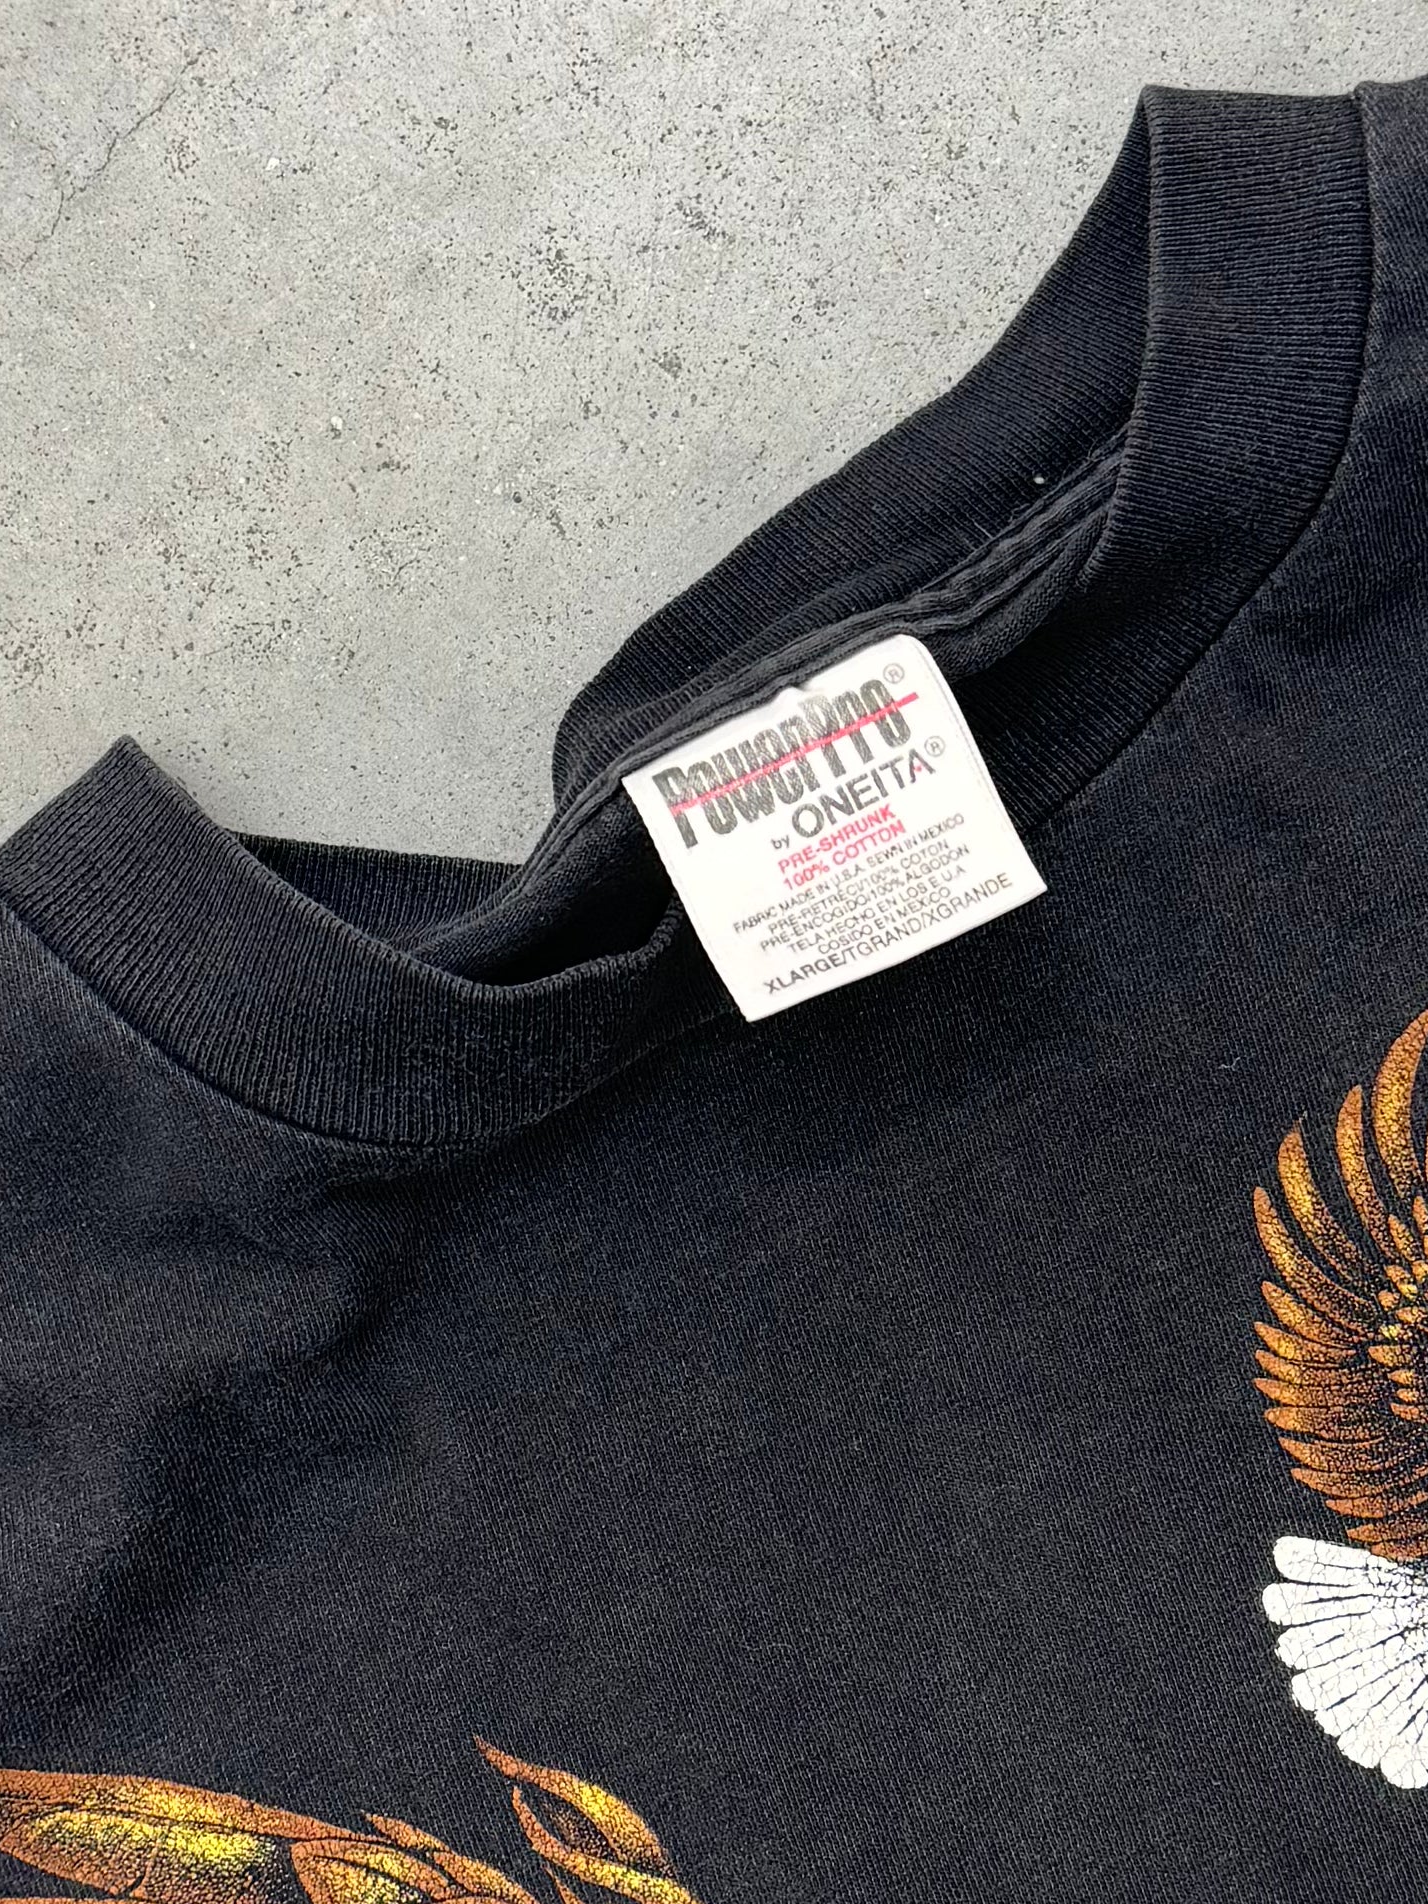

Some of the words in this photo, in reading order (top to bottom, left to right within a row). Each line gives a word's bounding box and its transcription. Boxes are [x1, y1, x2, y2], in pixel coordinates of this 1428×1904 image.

[771, 835, 790, 850] by
[791, 748, 936, 839] ONEITA
[733, 907, 778, 934] FABRIC
[779, 888, 813, 914] MADE
[816, 882, 830, 894] IN
[866, 844, 904, 867] SEWN
[904, 836, 918, 849] IN
[918, 813, 964, 843] MEXICO
[778, 804, 896, 874] PRE-SHRUNK
[783, 862, 830, 891] 100%
[832, 820, 906, 866] COTTON
[900, 839, 950, 870] COTON
[905, 844, 970, 884] ALGODON
[788, 933, 823, 954] TELA
[824, 910, 875, 942] HECHO
[878, 897, 898, 910] EN
[901, 882, 928, 902] LOS
[818, 924, 872, 954] COSIDO
[875, 913, 896, 929] EN
[896, 887, 951, 918] MEXICO
